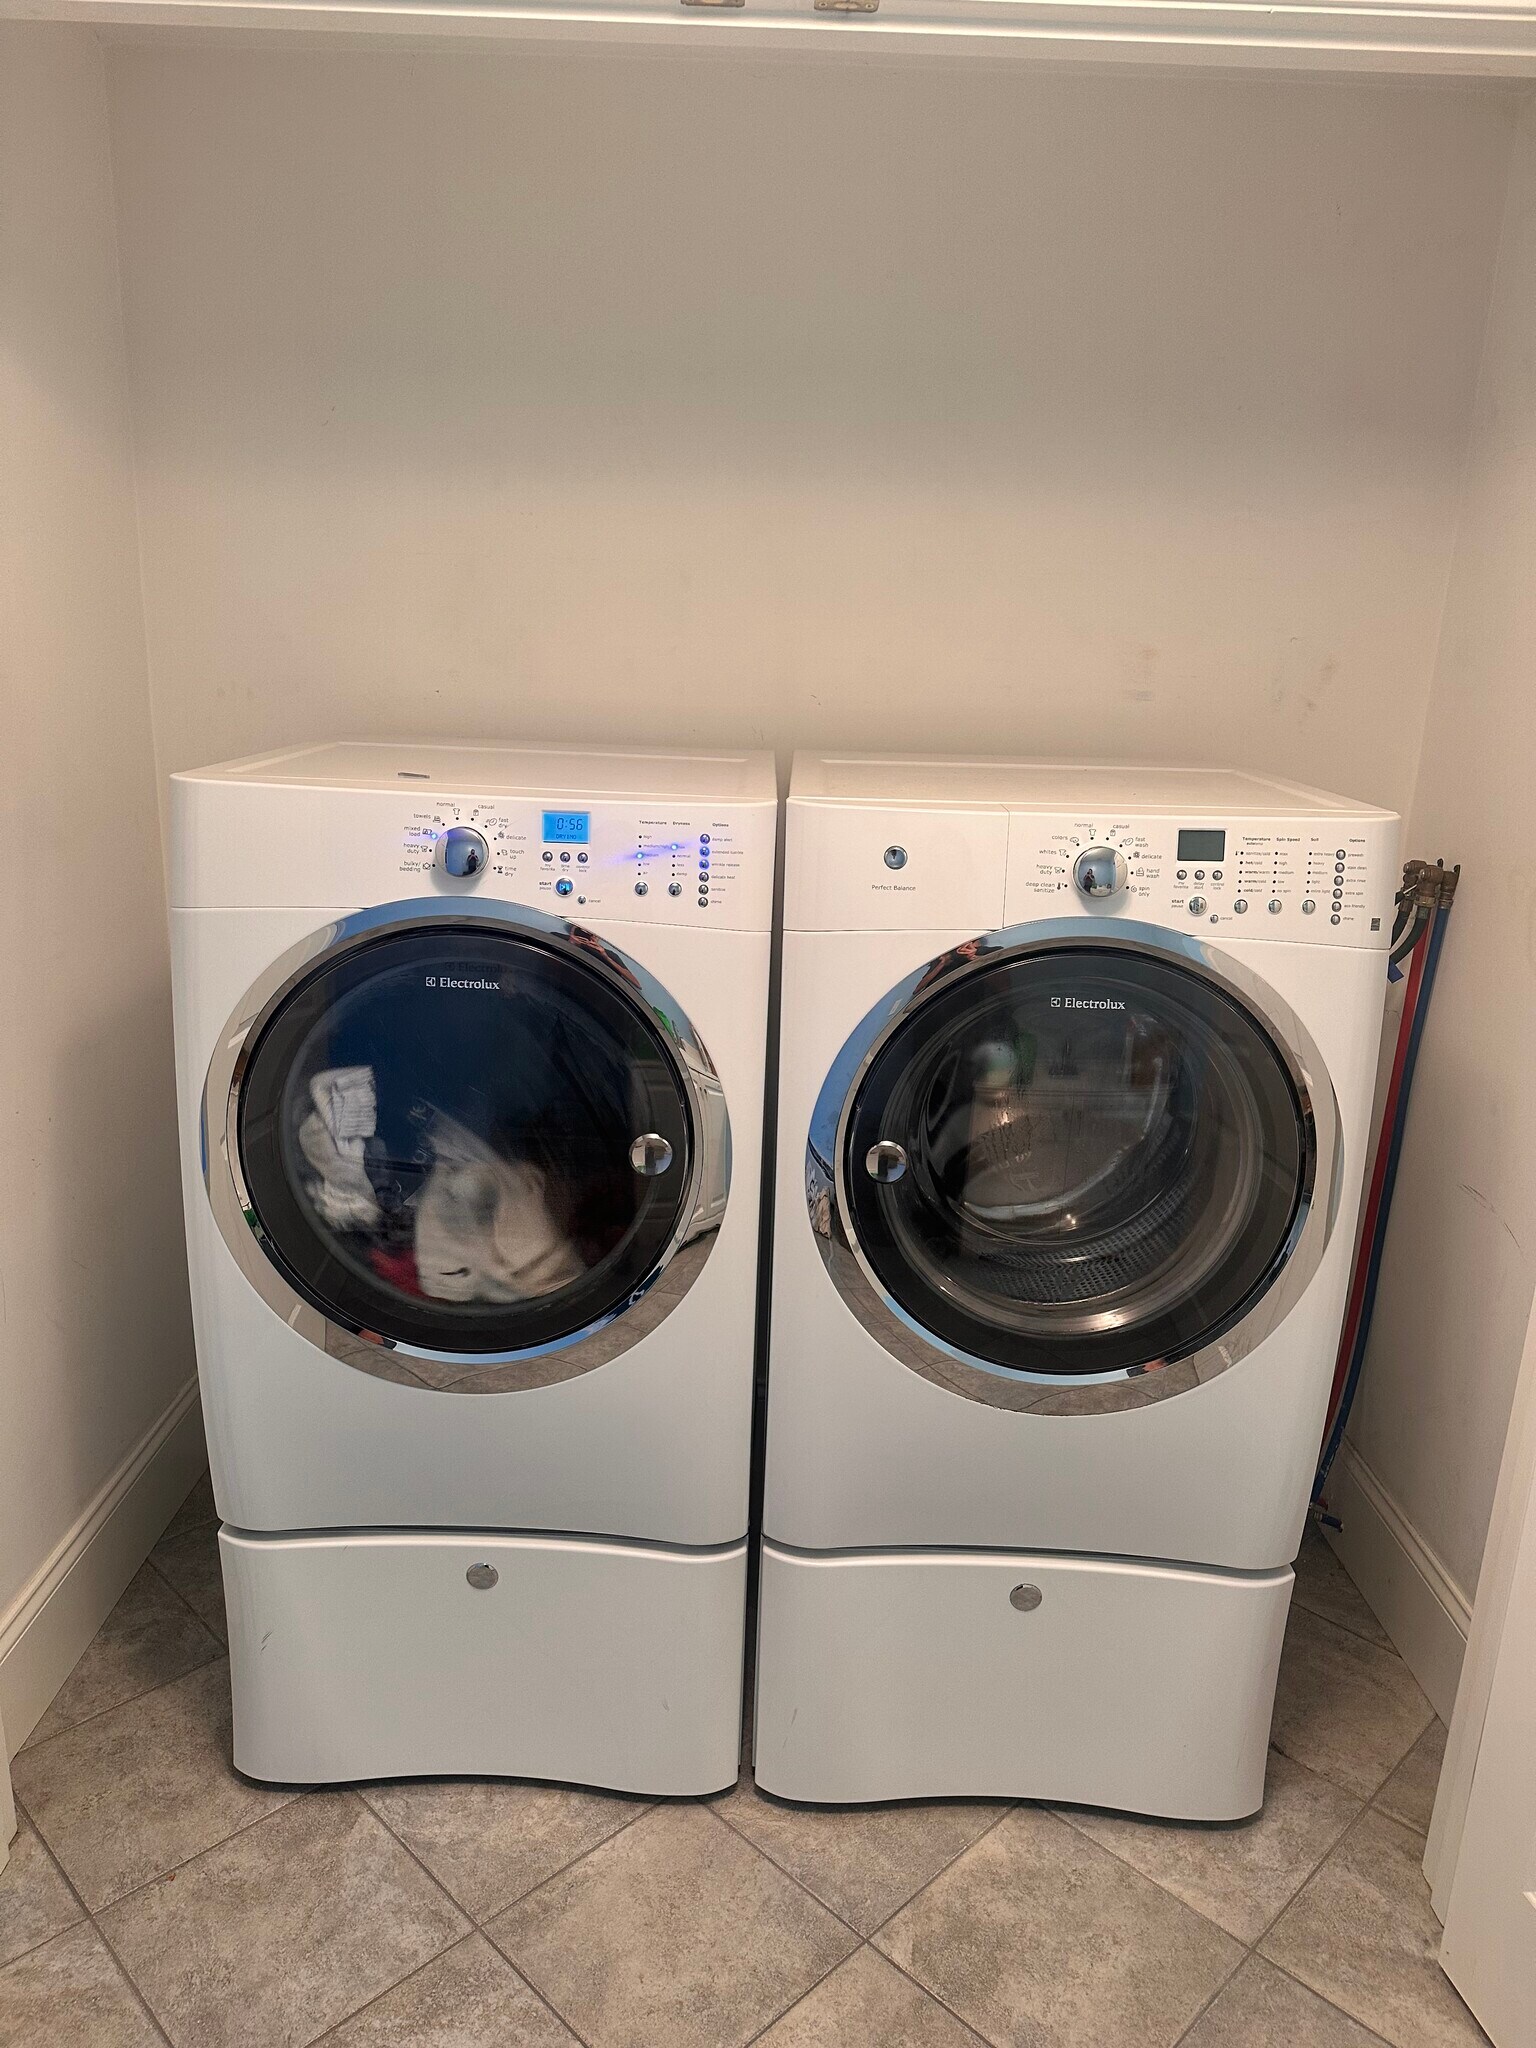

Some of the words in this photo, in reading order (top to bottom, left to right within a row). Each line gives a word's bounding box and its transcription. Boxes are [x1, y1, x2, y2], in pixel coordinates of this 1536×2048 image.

[557, 817, 583, 830] 0:56
[440, 977, 500, 990] Electrolux
[1065, 997, 1125, 1010] Electrolux
